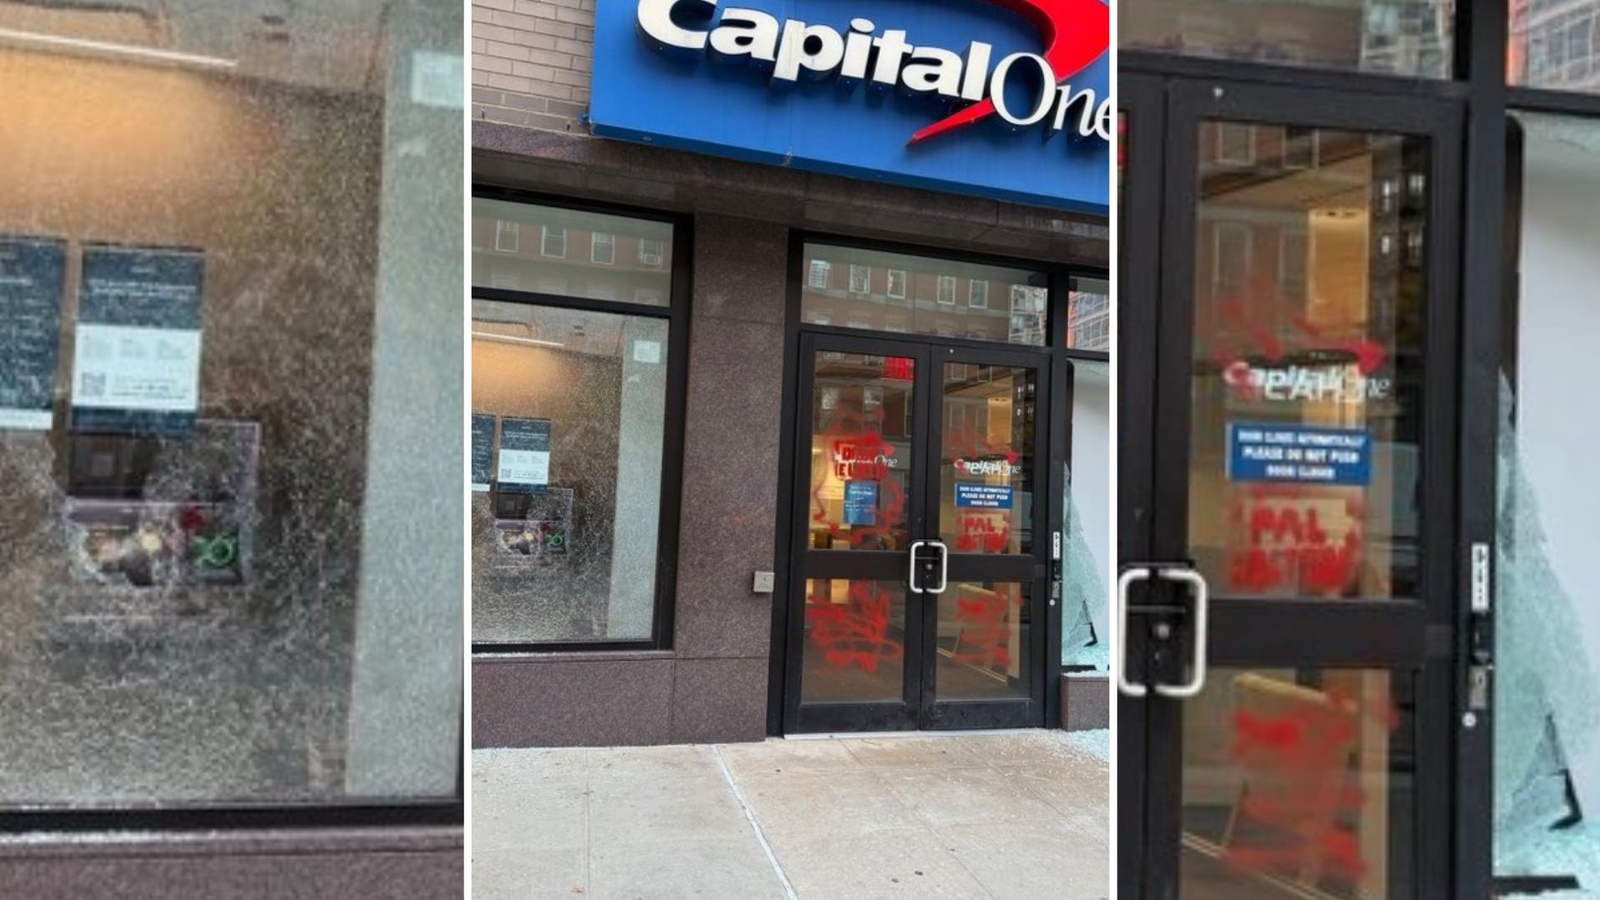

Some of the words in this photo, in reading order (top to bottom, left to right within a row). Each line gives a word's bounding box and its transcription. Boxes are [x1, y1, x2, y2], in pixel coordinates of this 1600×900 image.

[636, 0, 992, 101] Capital
[1241, 446, 1283, 460] PLEASE
[1285, 447, 1302, 460] DO
[1304, 448, 1328, 462] NOT
